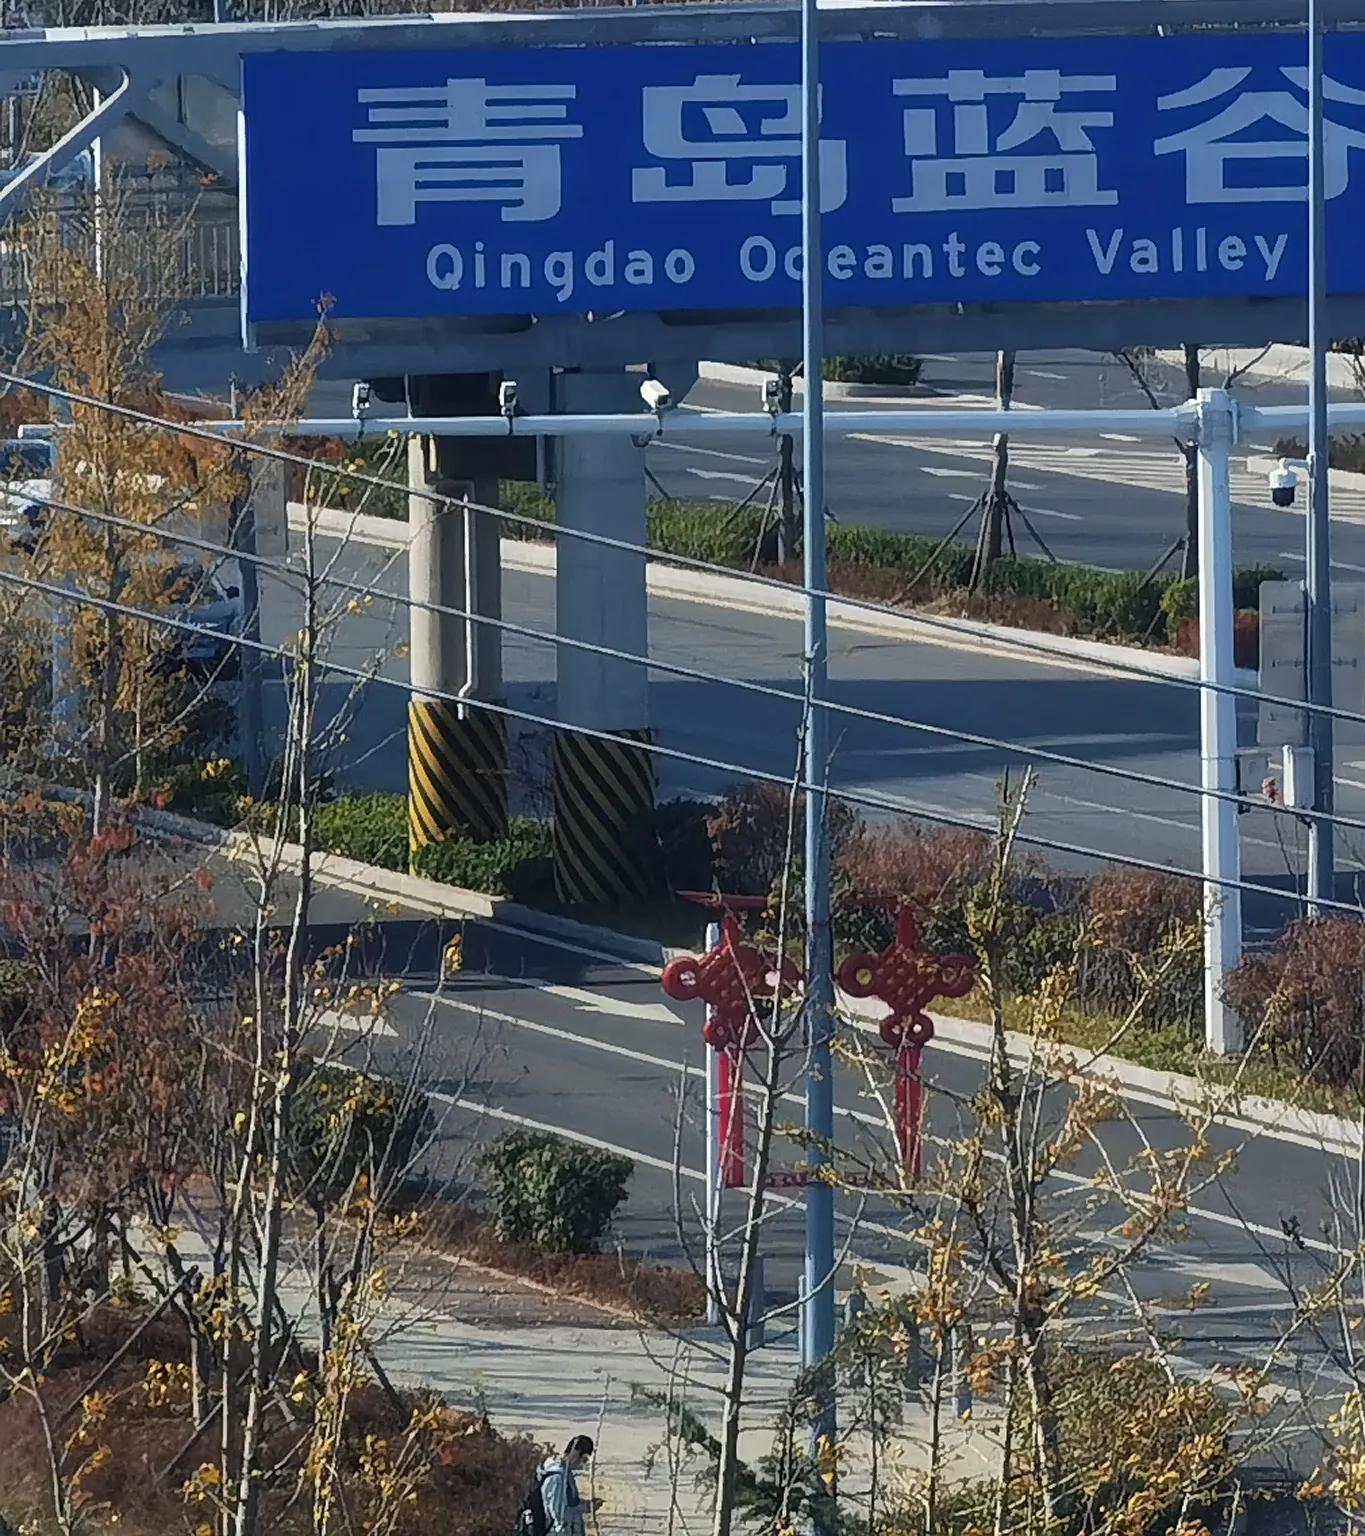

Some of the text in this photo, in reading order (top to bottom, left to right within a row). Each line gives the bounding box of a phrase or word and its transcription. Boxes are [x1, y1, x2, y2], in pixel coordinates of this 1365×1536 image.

[426, 240, 696, 303] Qingdao
[739, 231, 1041, 283] Oceantec
[1085, 227, 1289, 281] Valley
